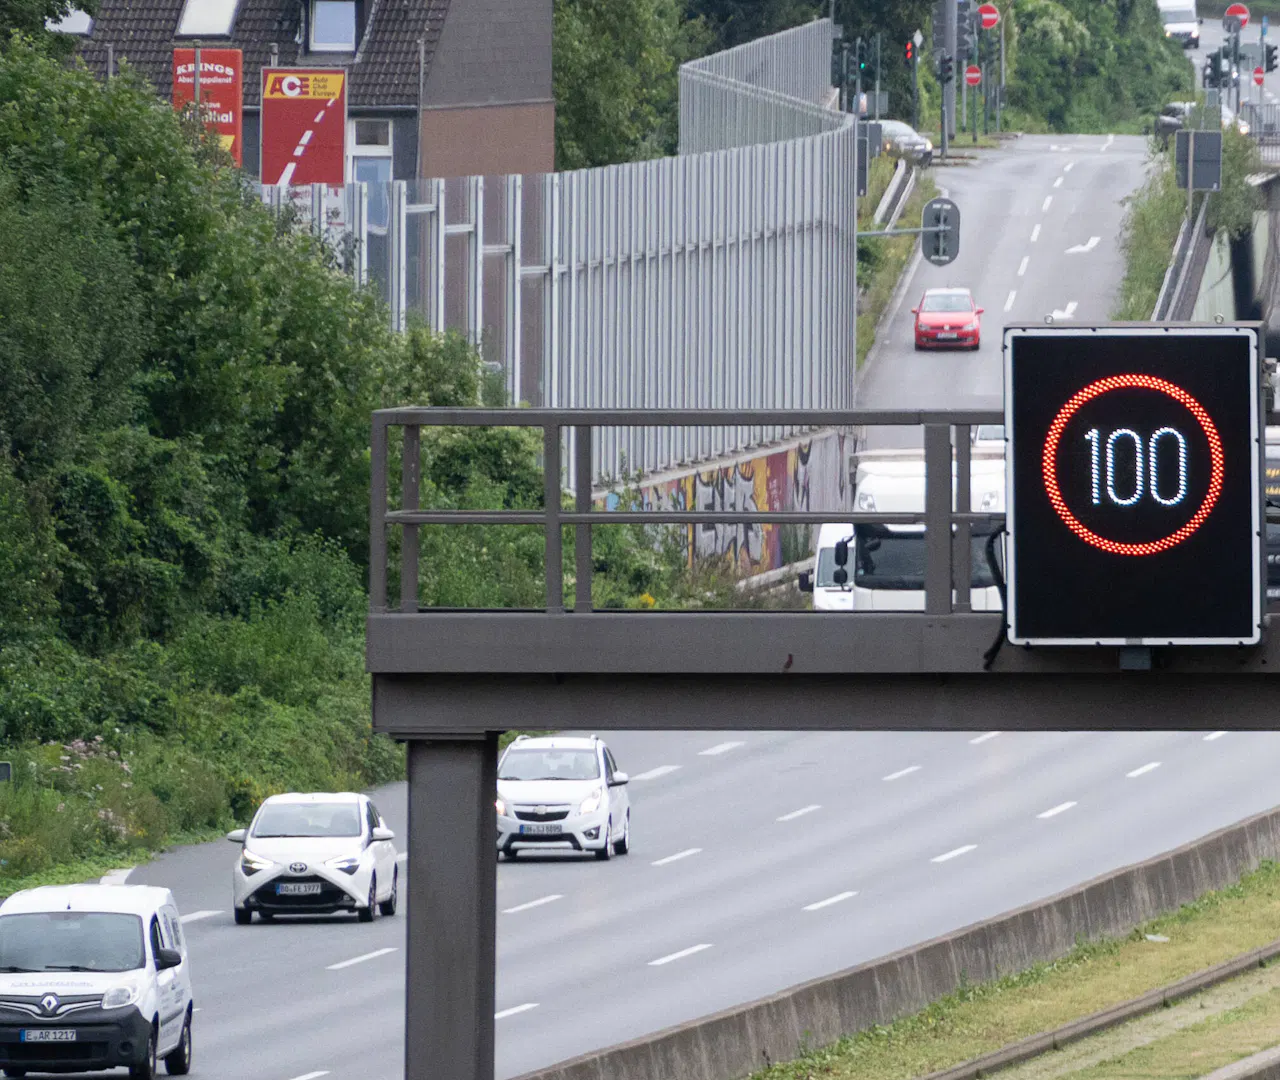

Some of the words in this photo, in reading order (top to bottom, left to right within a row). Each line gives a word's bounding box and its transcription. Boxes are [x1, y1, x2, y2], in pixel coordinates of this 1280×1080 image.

[270, 76, 309, 96] ACE
[1085, 427, 1187, 505] 100
[53, 1031, 75, 1040] 1217
